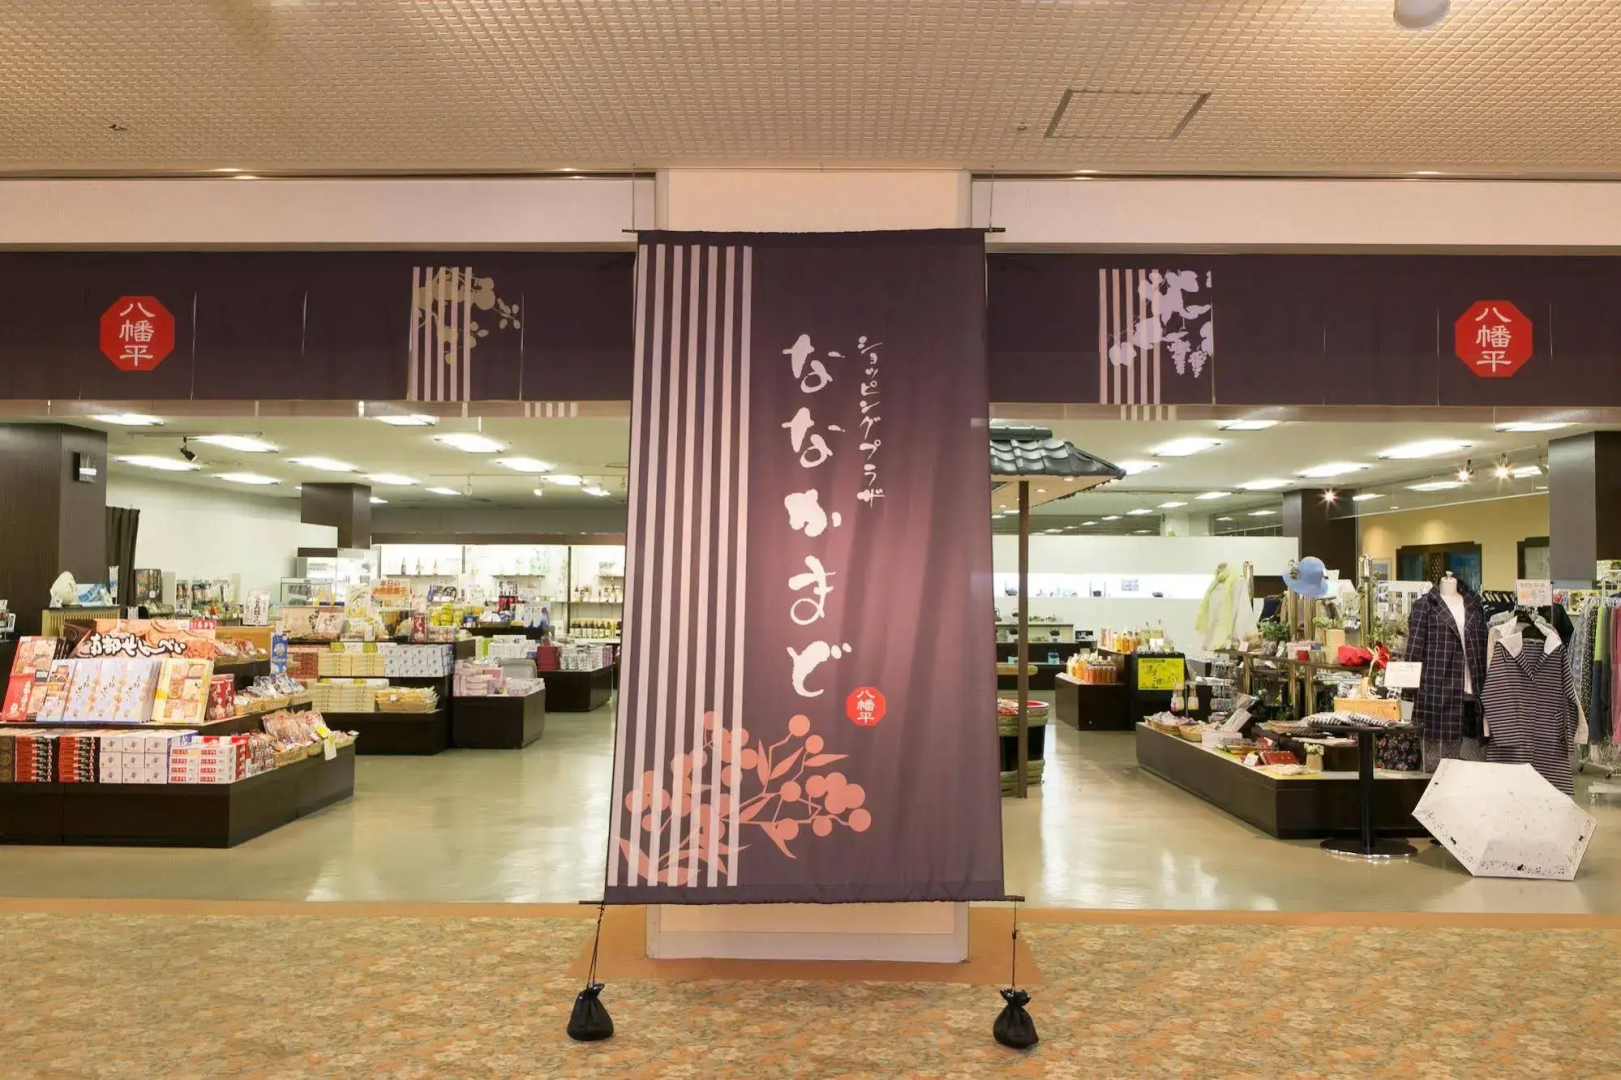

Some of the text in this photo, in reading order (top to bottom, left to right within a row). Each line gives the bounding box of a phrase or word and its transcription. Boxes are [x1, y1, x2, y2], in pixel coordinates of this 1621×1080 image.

[118, 302, 155, 367] 八幡平
[1475, 307, 1512, 373] 八幡平
[856, 335, 886, 508] ショッピングプラザ
[782, 333, 852, 698] ななかまど
[856, 690, 876, 724] 八幡平
